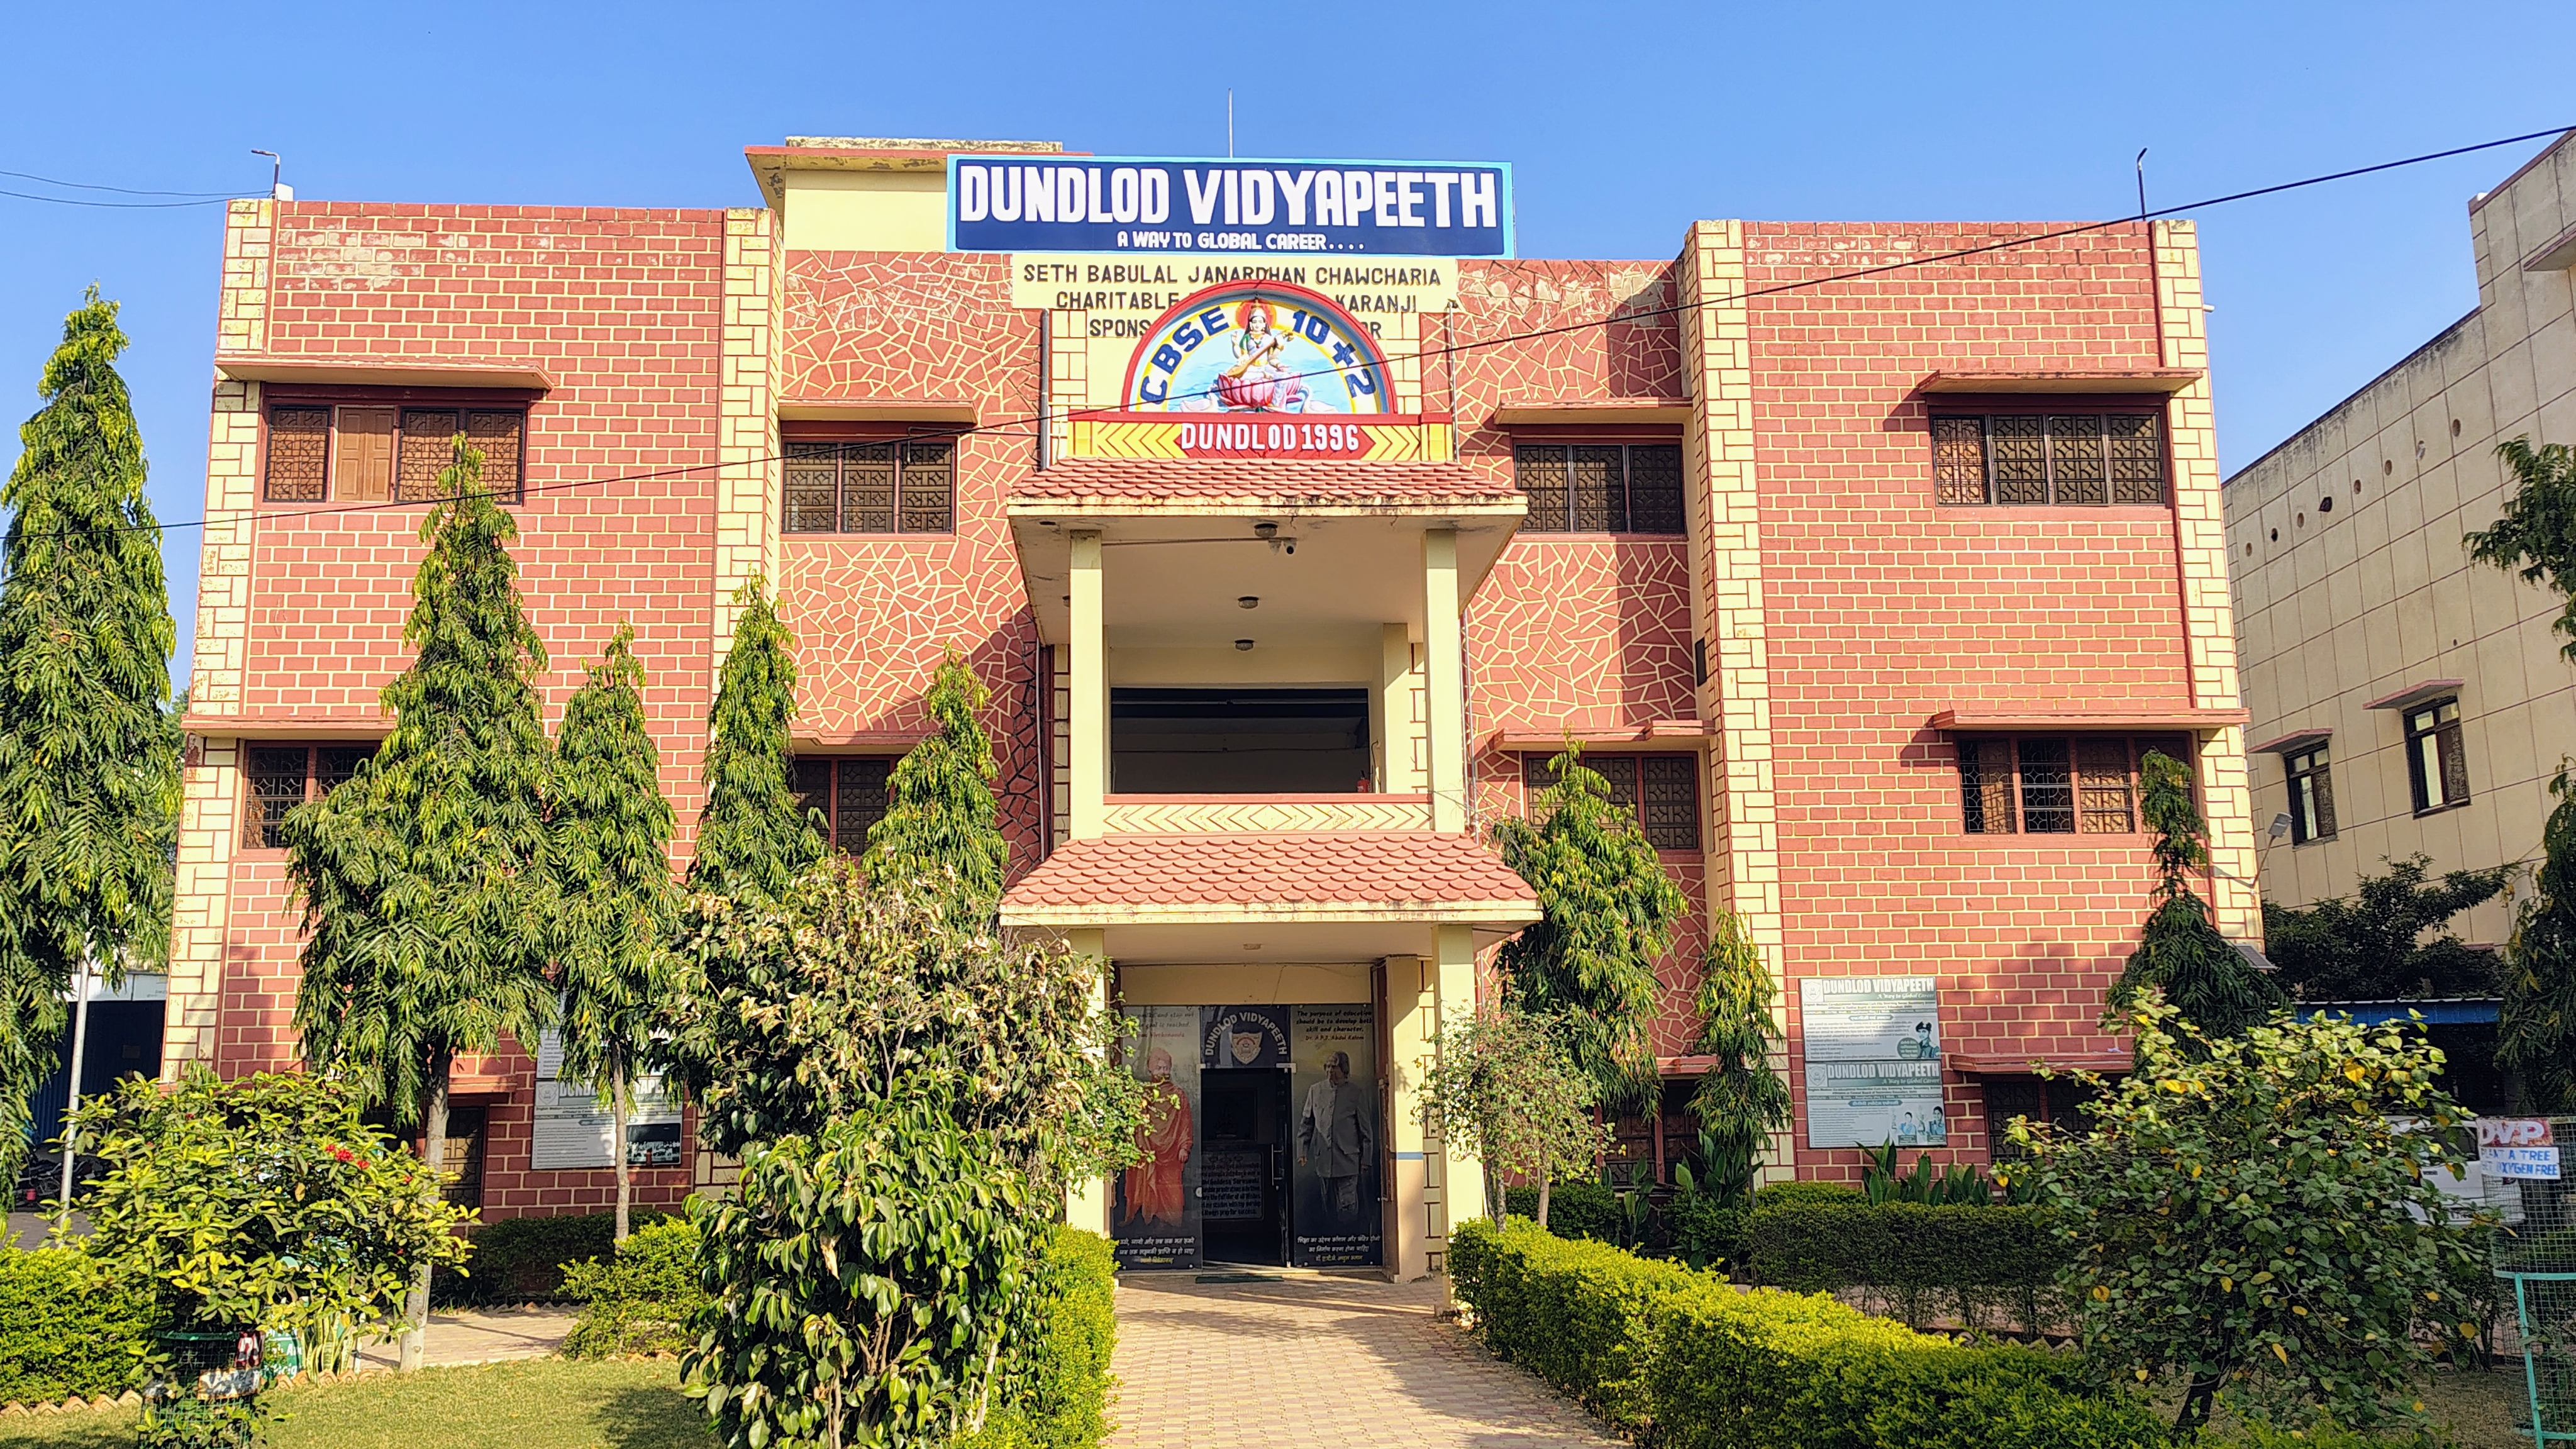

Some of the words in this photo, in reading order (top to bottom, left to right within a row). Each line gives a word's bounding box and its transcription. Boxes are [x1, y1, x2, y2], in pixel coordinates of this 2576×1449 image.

[960, 166, 1169, 223] DUNDLOD
[1184, 169, 1496, 228] VIDYAPEETH
[1117, 231, 1128, 248] A
[1132, 231, 1170, 248] WAY
[1173, 232, 1192, 248] TO
[1197, 233, 1262, 249] GLOBAL
[1024, 264, 1077, 282] SETH
[1087, 265, 1177, 284] BABULAL
[1187, 265, 1306, 284] JANARDHAN
[1315, 267, 1441, 286] CHAWCHARIA
[1057, 291, 1180, 310] CHARITABLE
[1335, 294, 1416, 313] KARANJI
[1140, 306, 1230, 405] CBSE
[1292, 309, 1377, 399] 10+2
[1181, 423, 1297, 452] DUNDLOD
[1301, 424, 1359, 452] 1996
[1824, 979, 1871, 994] DUNDLOD
[1872, 978, 1934, 993] VIDYAPEETH
[1205, 1014, 1238, 1056] DUNDLOD
[1239, 1011, 1287, 1055] VIDYAPEETH
[1828, 1064, 1876, 1079] DUNDLOD
[1878, 1063, 1940, 1078] VIDYAPEETH
[2479, 1120, 2545, 1145] DVP
[2508, 1150, 2516, 1160] A
[2519, 1150, 2551, 1161] TREE
[2535, 1164, 2558, 1175] FREE
